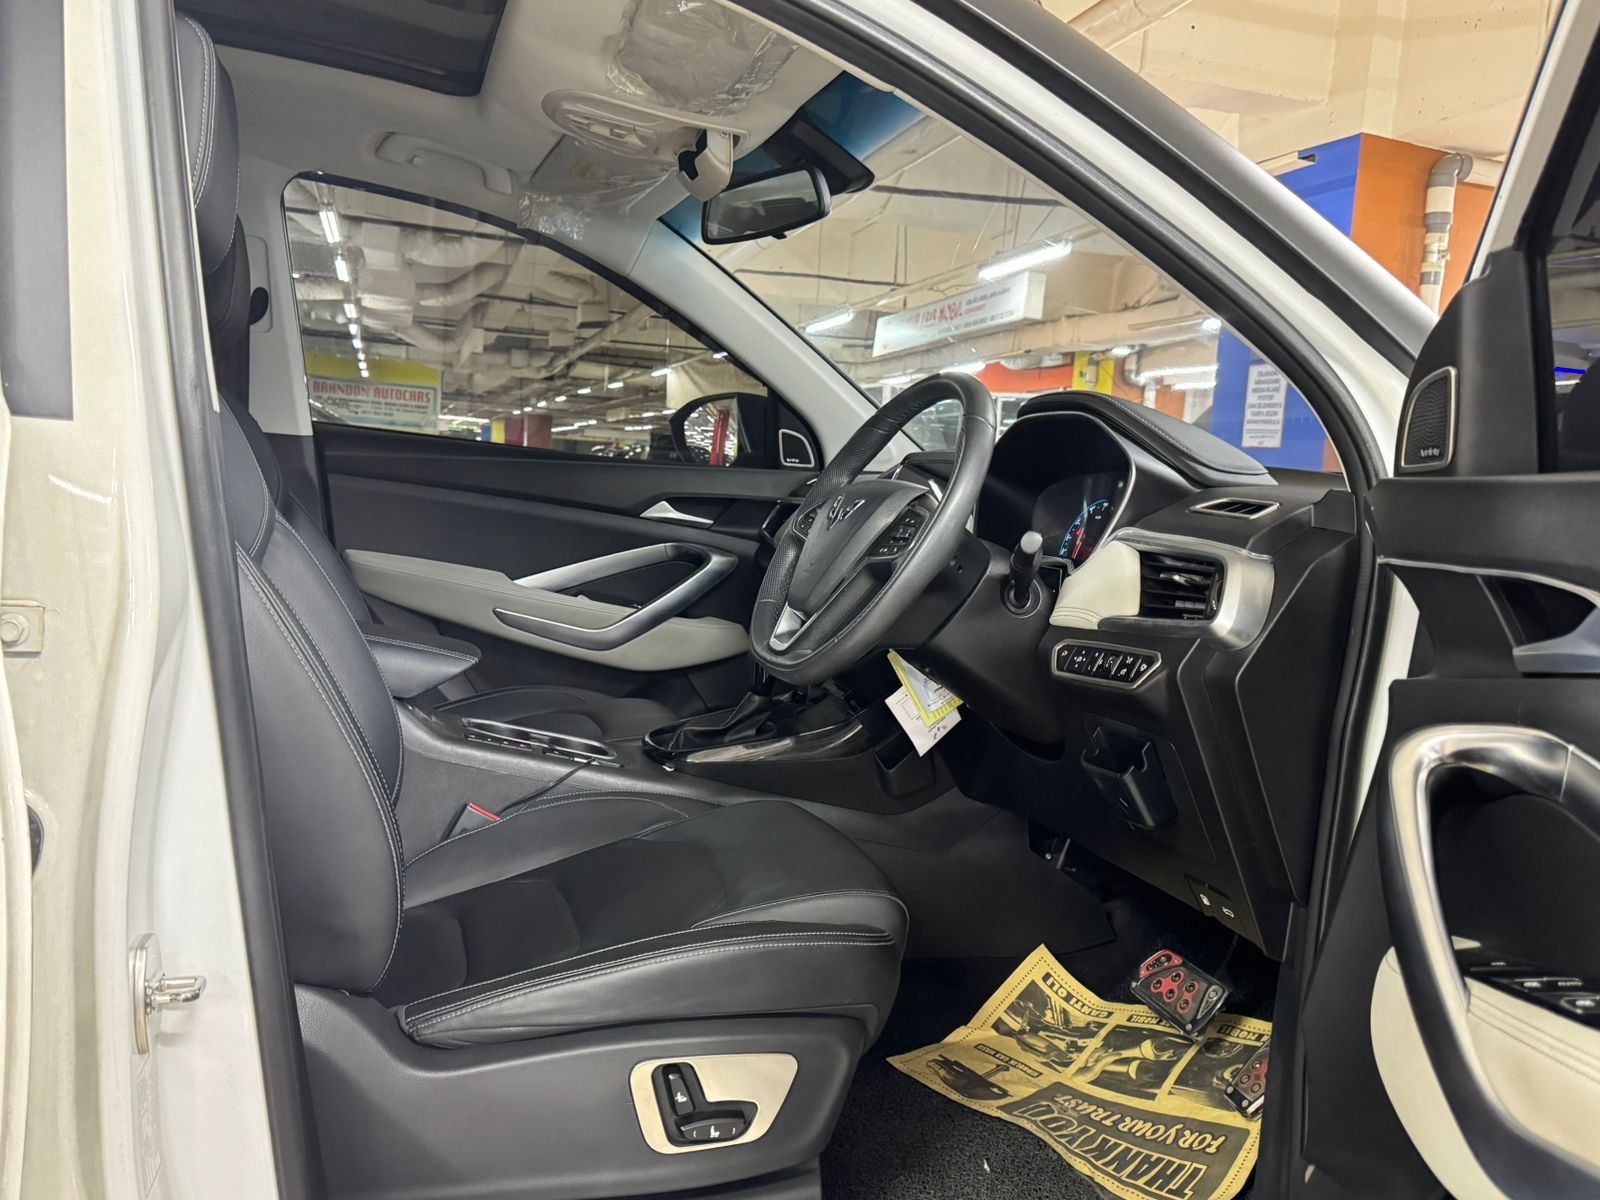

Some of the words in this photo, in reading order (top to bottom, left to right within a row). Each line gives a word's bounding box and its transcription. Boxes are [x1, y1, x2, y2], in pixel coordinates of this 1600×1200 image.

[313, 380, 369, 398] BRANDON
[374, 387, 432, 404] AUTOCARS
[1045, 976, 1068, 999] OLI
[1069, 996, 1109, 1018] GANTI
[1129, 1015, 1160, 1026] MOBIL
[1219, 1025, 1259, 1041] MOBIL
[1054, 1094, 1116, 1126] TRUST
[1013, 1101, 1097, 1153] YOU
[1117, 1118, 1182, 1145] YOUR
[1179, 1129, 1227, 1154] FOR
[1084, 1134, 1208, 1200] THANK
